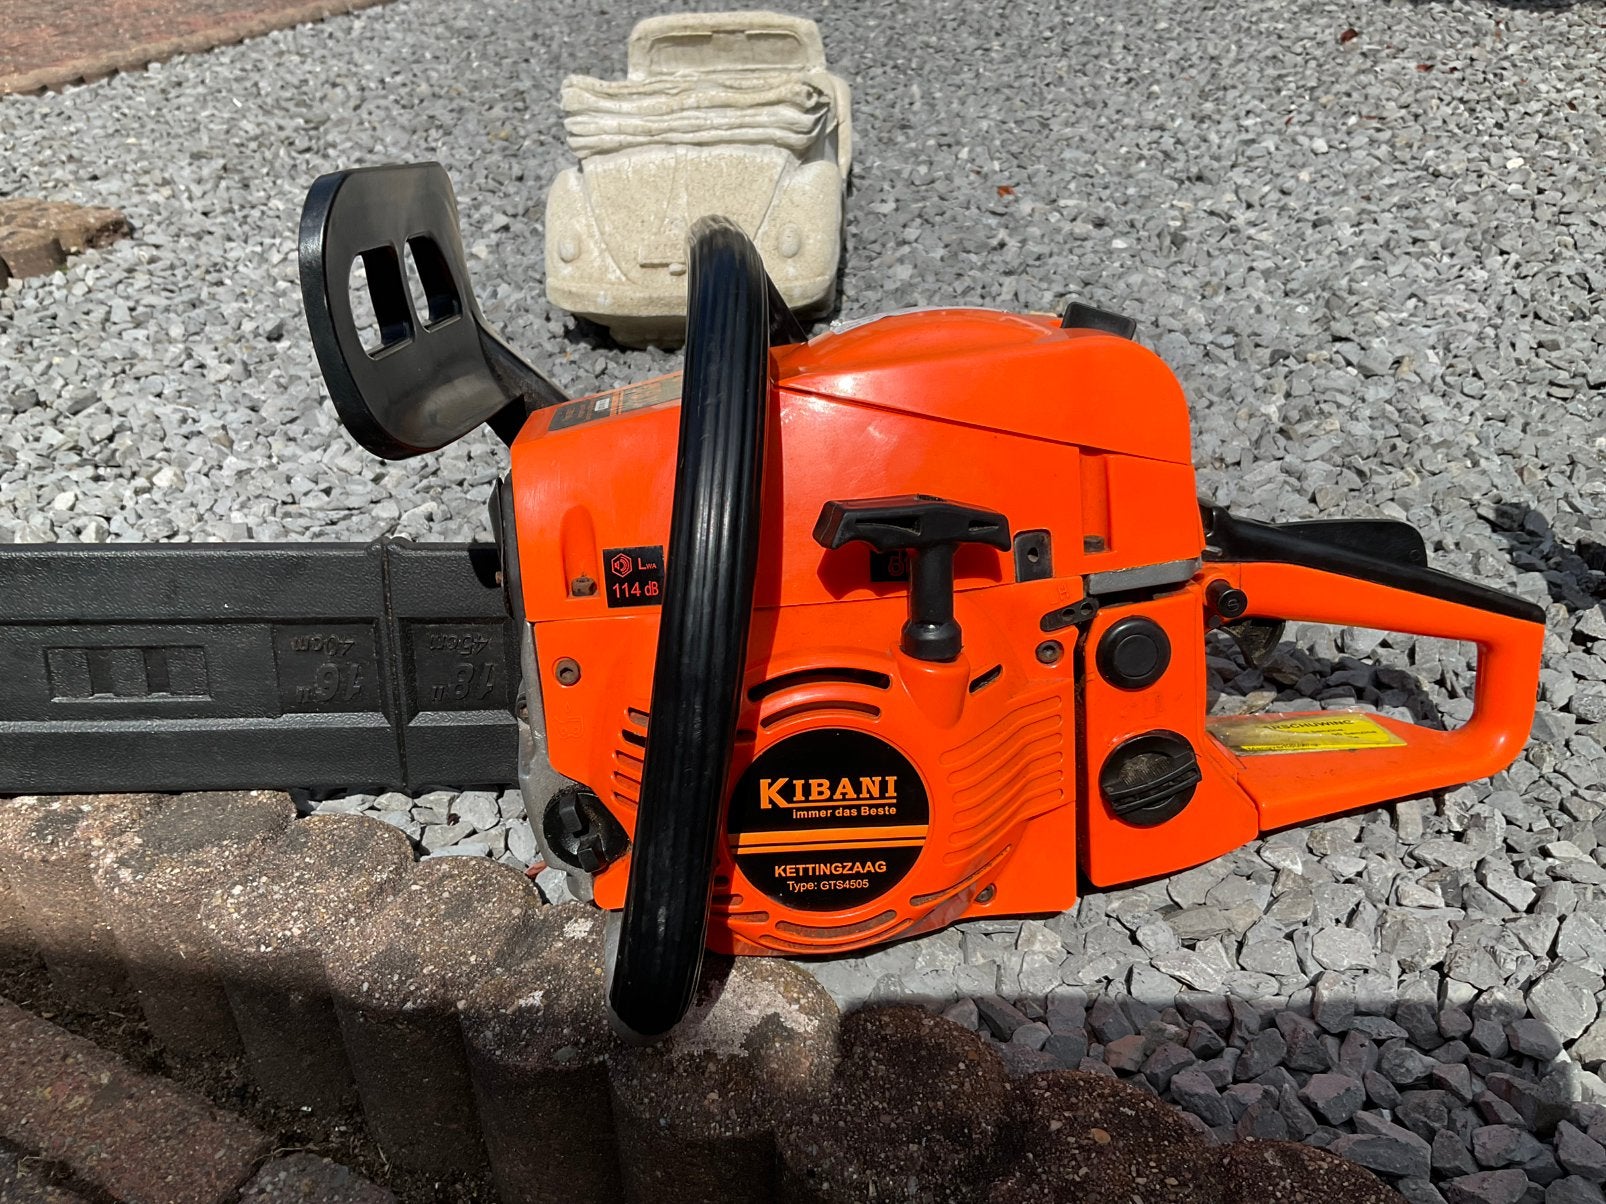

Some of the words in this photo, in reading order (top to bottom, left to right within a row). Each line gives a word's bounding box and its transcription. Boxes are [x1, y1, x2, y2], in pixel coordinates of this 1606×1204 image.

[612, 581, 642, 599] 114
[644, 580, 659, 597] dB
[759, 776, 898, 810] KIBANI
[792, 808, 833, 819] immer
[835, 806, 858, 817] das
[861, 805, 897, 816] Beste
[774, 861, 887, 878] KETTINGZAAG
[787, 880, 818, 892] Type:
[820, 879, 869, 890] GTS4505
